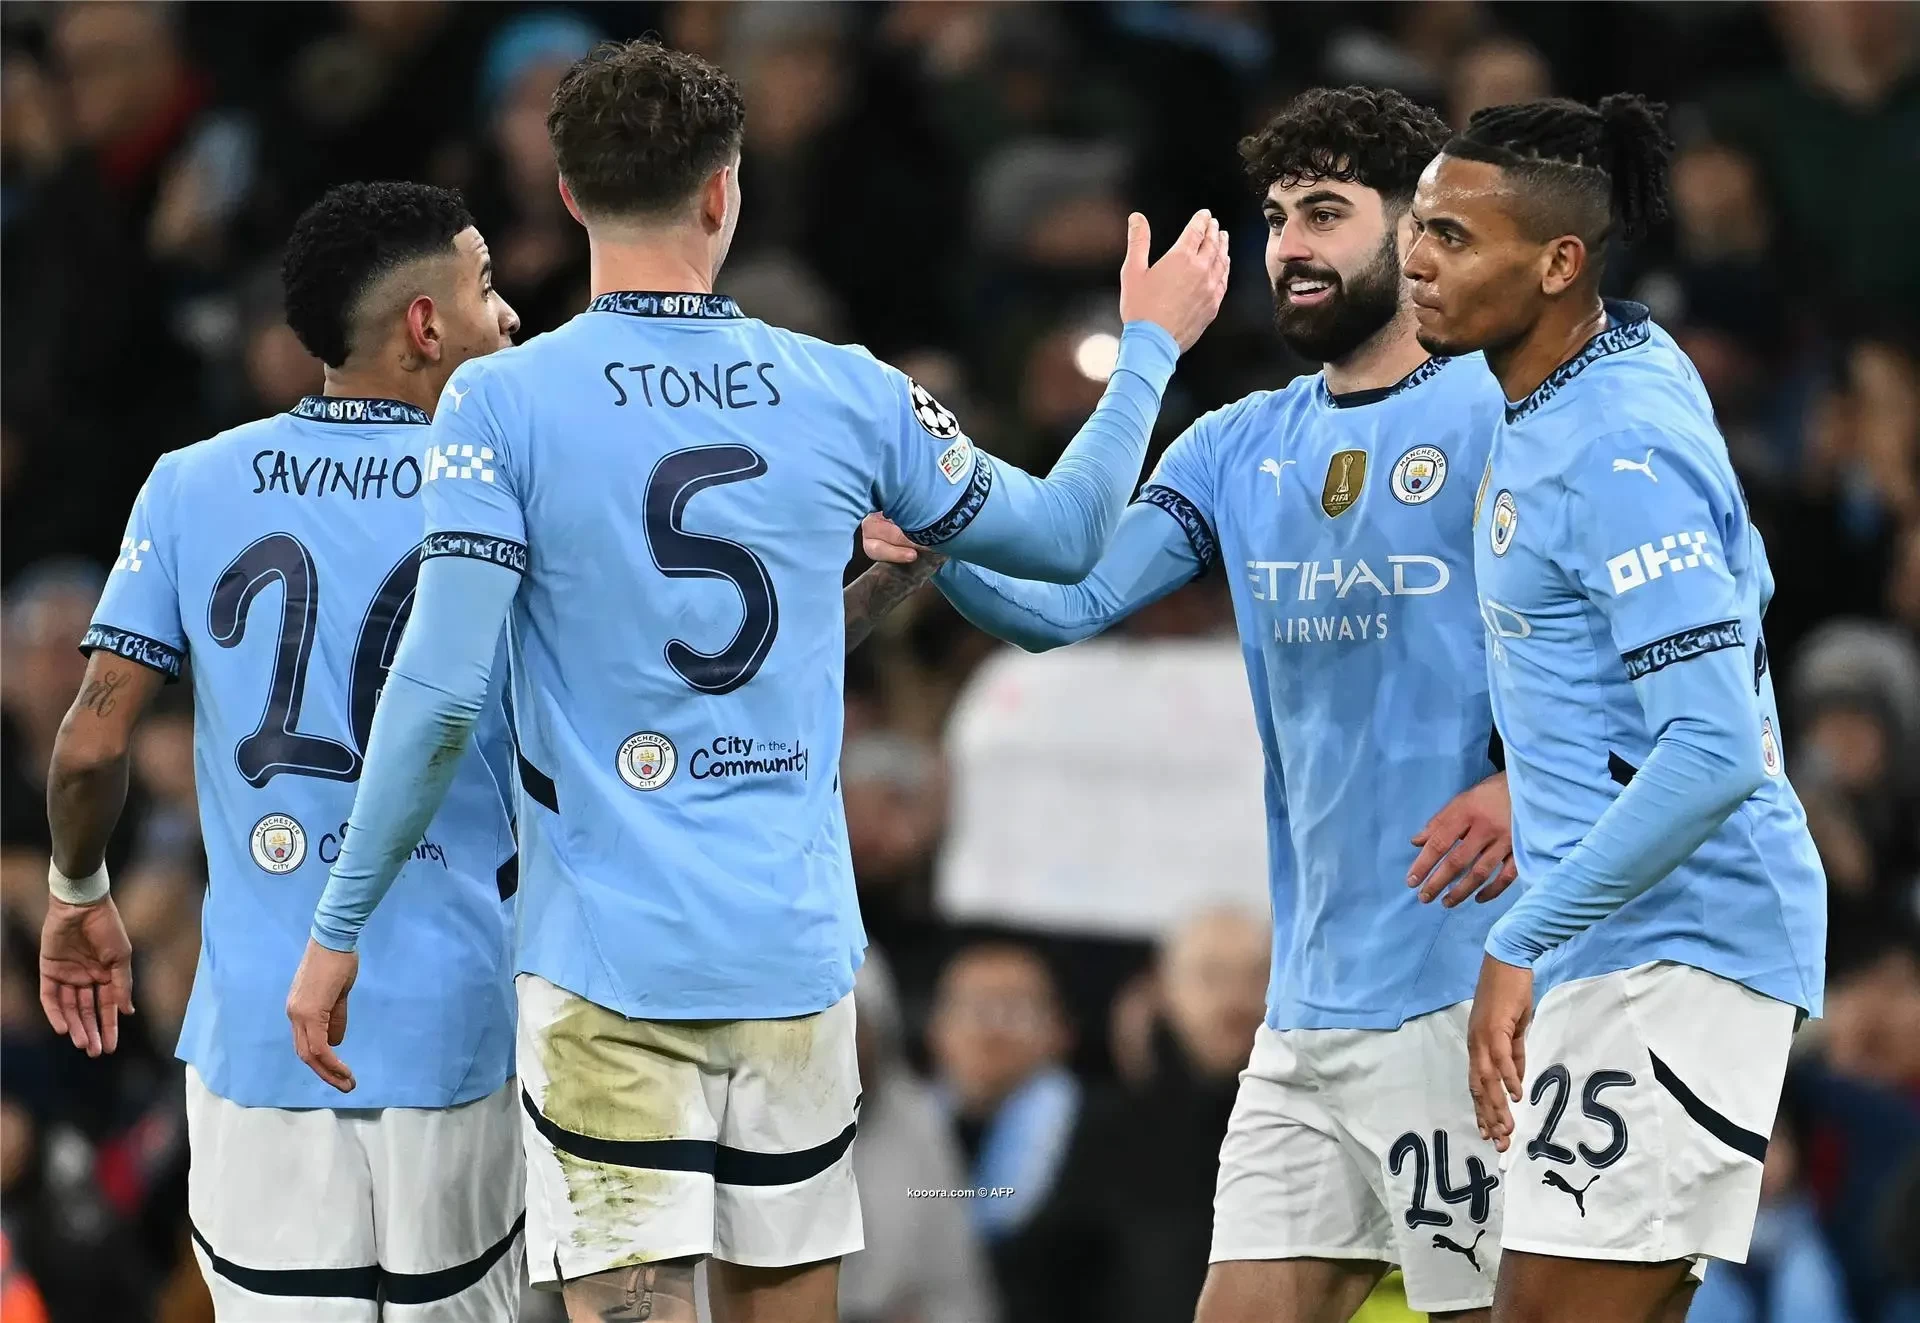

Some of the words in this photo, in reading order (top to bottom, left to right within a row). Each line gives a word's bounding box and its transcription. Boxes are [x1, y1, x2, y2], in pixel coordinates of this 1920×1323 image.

[605, 361, 781, 410] STONES
[940, 449, 956, 466] UEFA
[1400, 449, 1444, 469] MANCHESTER
[252, 450, 422, 501] SAVINHO
[1330, 493, 1349, 503] FIFA
[1404, 494, 1422, 502] CITY
[643, 443, 779, 696] 5
[1246, 555, 1450, 601] ETIHAD
[1274, 612, 1389, 644] AIRWAYS
[622, 735, 670, 755] MANCHESTER
[712, 736, 754, 757] City
[756, 743, 766, 752] in
[768, 740, 787, 752] the
[689, 739, 808, 781] Community
[639, 780, 657, 788] CITY
[255, 817, 301, 838] MANCHESTER
[272, 863, 290, 871] CITY
[1526, 1062, 1637, 1169] 25
[1388, 1127, 1500, 1229] 24
